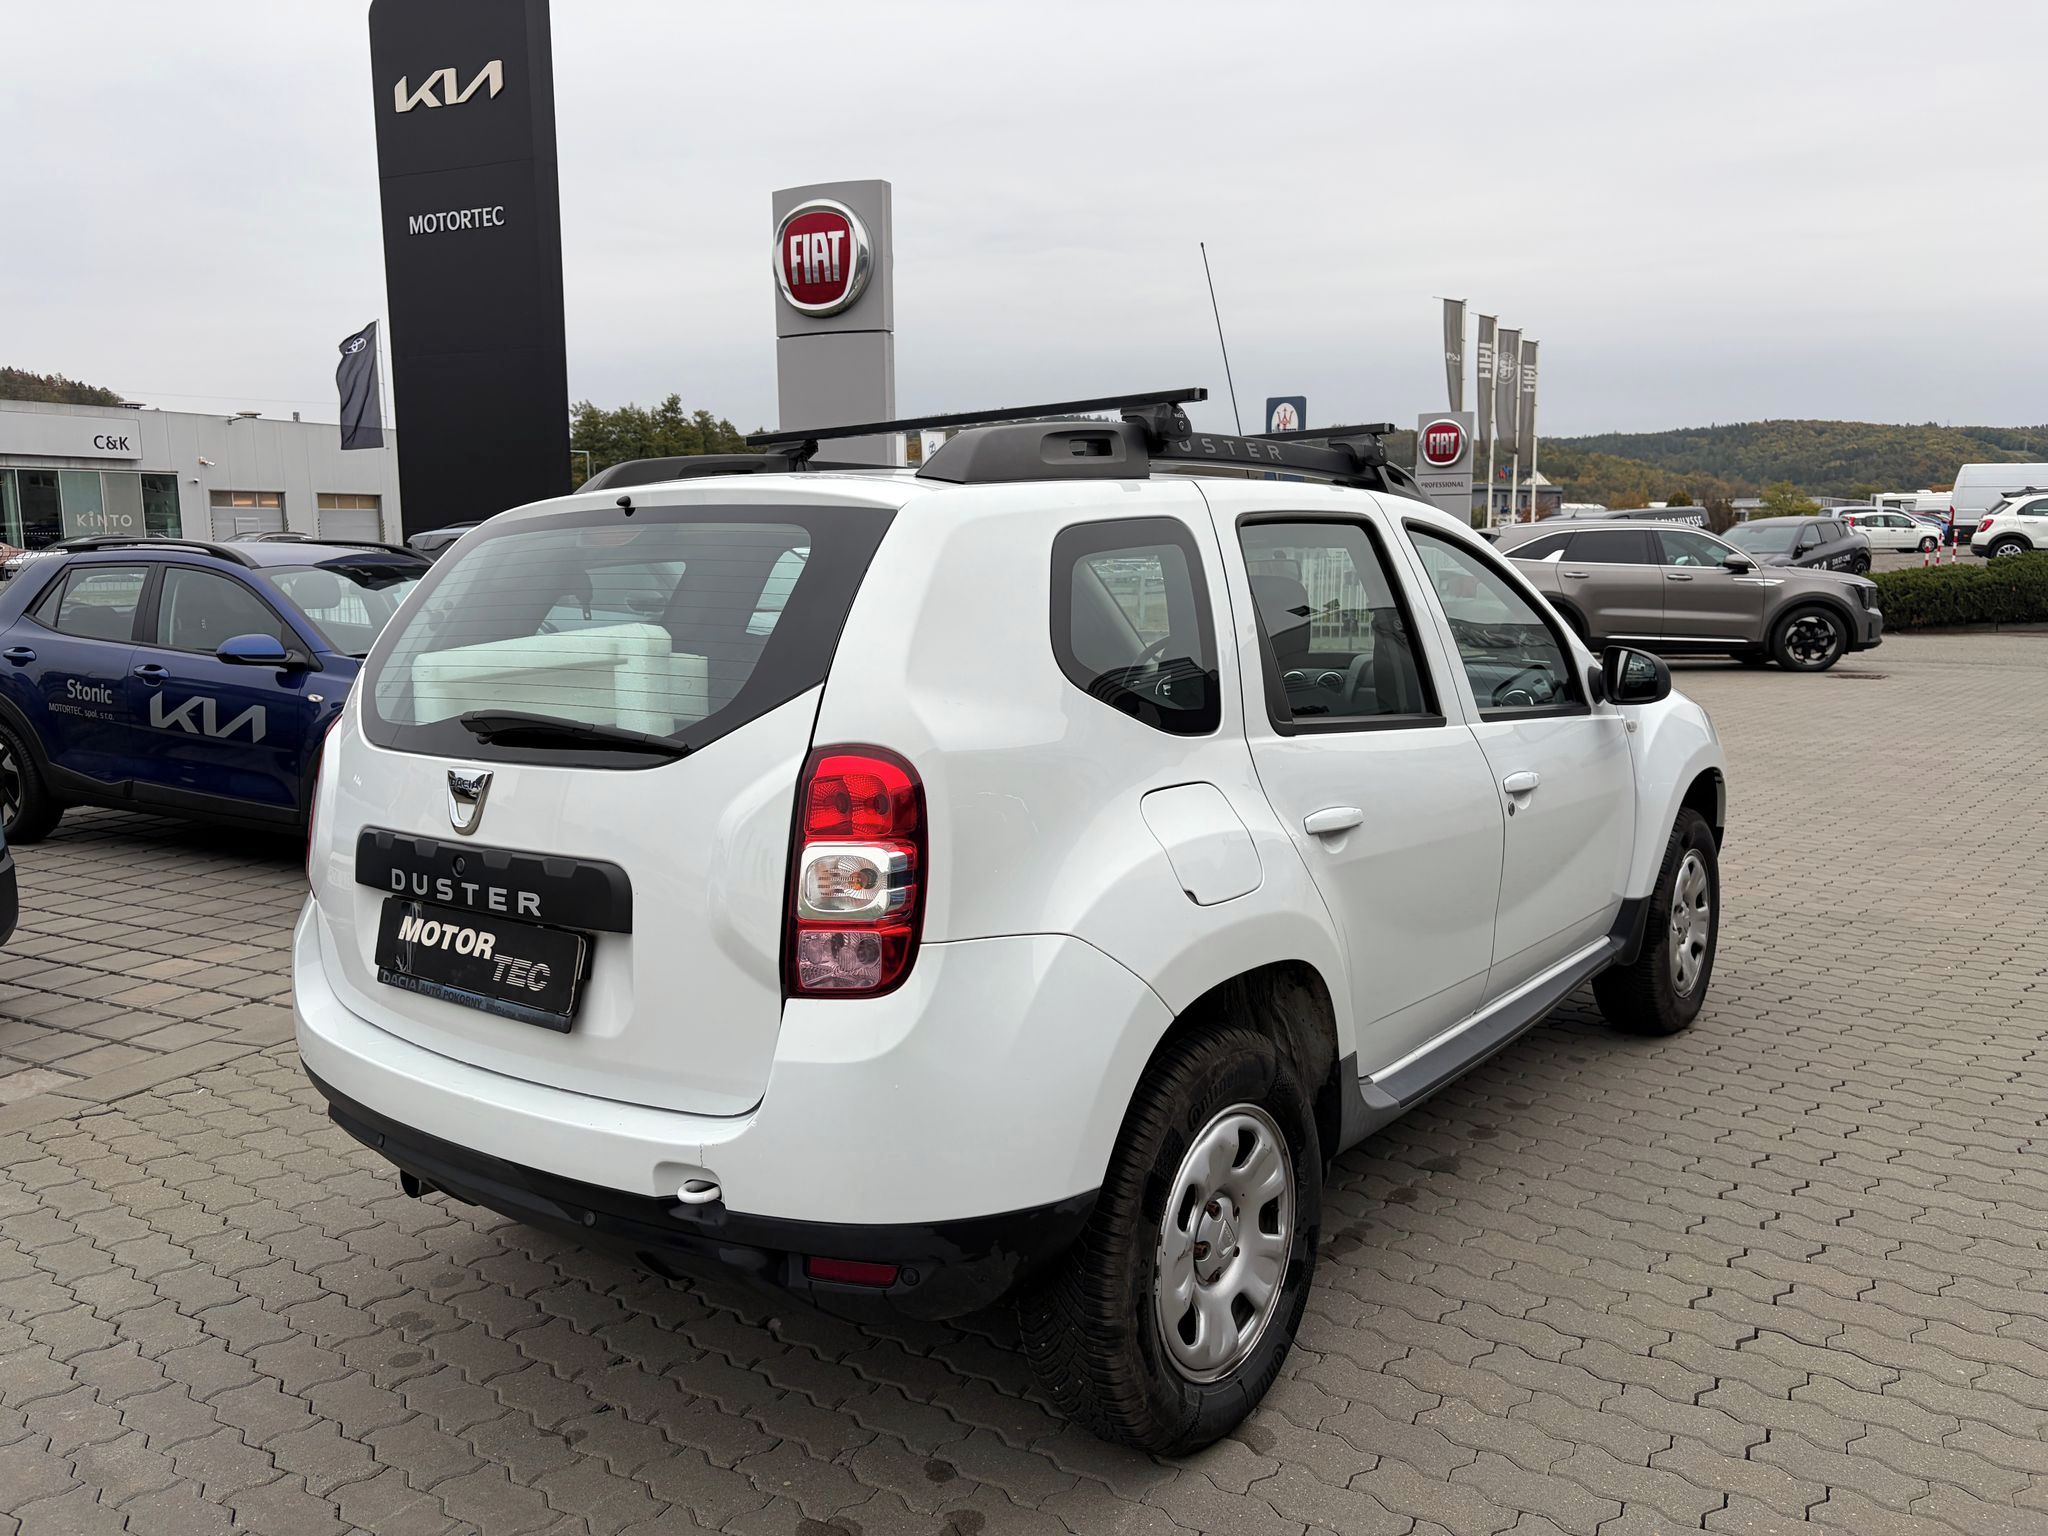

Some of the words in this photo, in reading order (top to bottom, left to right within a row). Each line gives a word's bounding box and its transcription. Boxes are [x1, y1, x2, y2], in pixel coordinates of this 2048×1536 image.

[394, 59, 504, 113] KIA
[408, 206, 505, 235] MOTORTEC
[790, 230, 845, 285] FIAT
[93, 434, 130, 451] C&K
[1175, 438, 1283, 461] USTER
[1429, 432, 1457, 455] FIAT
[1421, 481, 1464, 489] PROFESSIONAL
[66, 678, 113, 705] Stonic
[149, 690, 266, 744] KIA
[391, 868, 542, 917] DUSTER
[398, 915, 496, 960] MOTOR
[381, 971, 417, 991] DACIA
[492, 953, 551, 992] TEC
